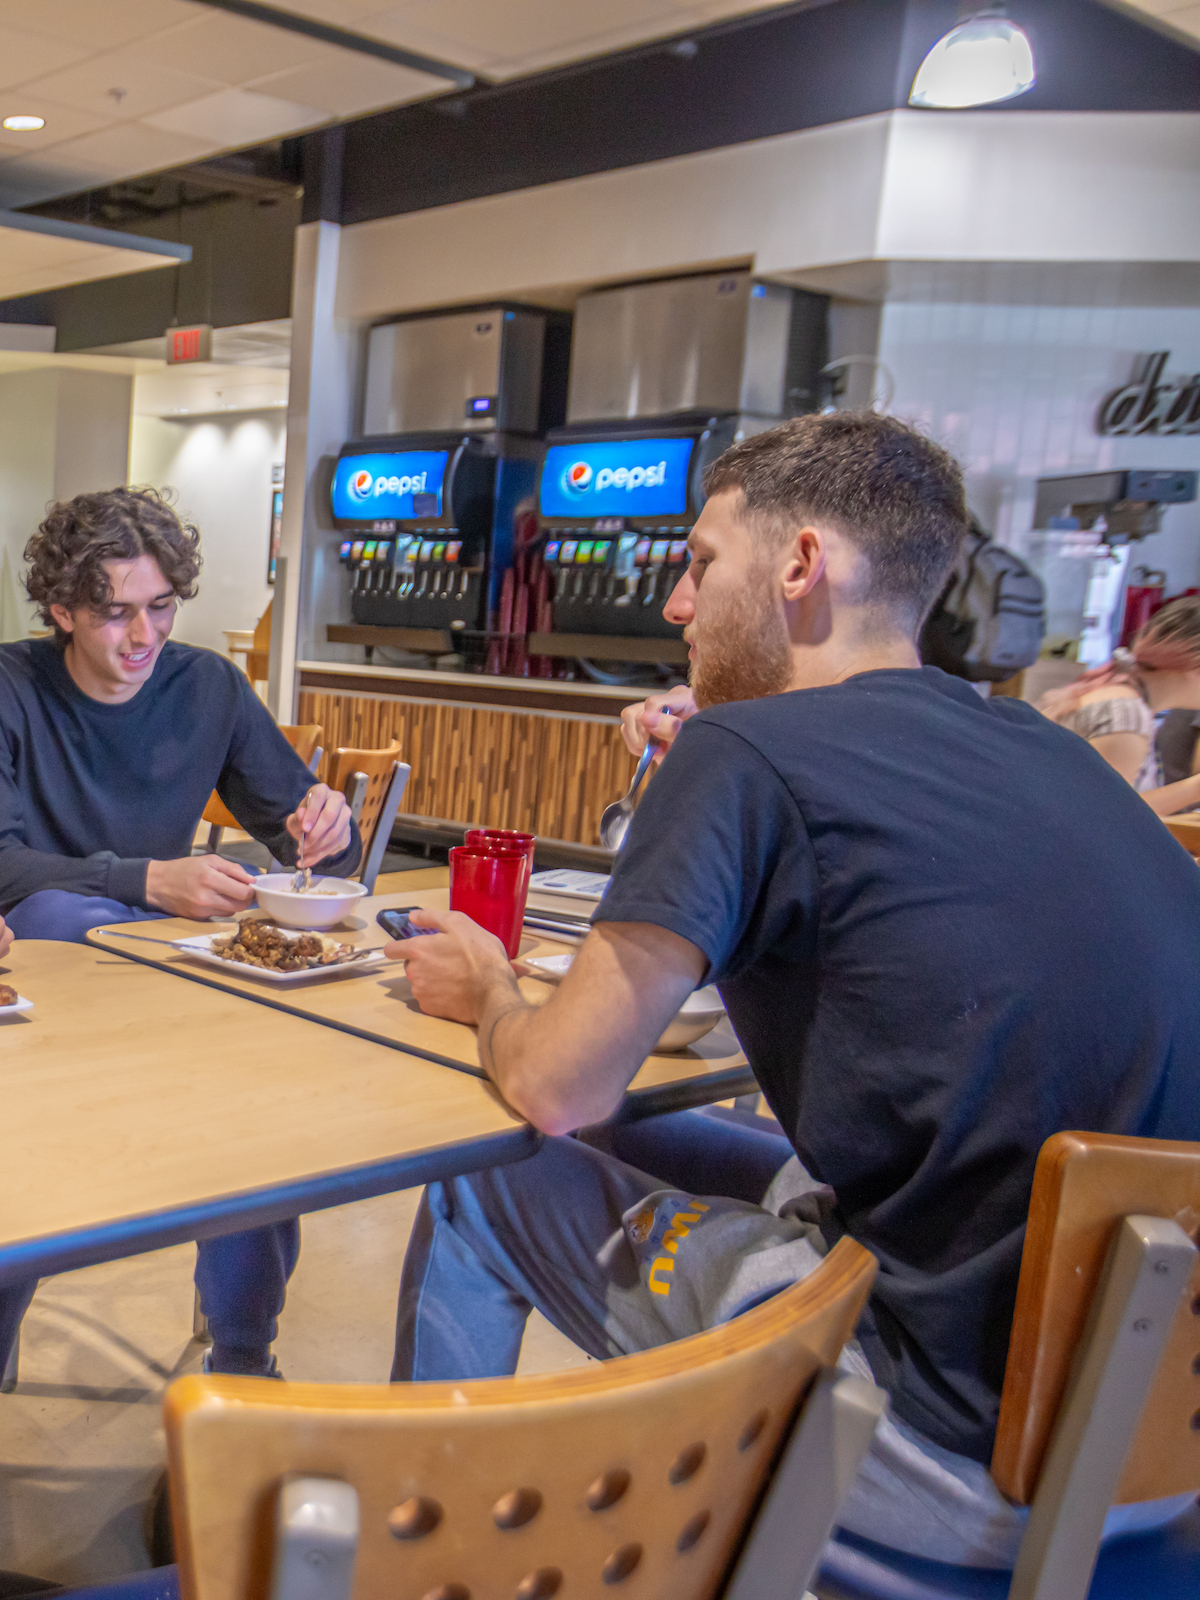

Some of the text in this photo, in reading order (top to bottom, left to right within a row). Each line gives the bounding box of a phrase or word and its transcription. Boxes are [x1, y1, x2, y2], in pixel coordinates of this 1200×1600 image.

[173, 329, 201, 361] EXIT
[373, 471, 428, 498] pepsi
[595, 460, 667, 494] pepsi
